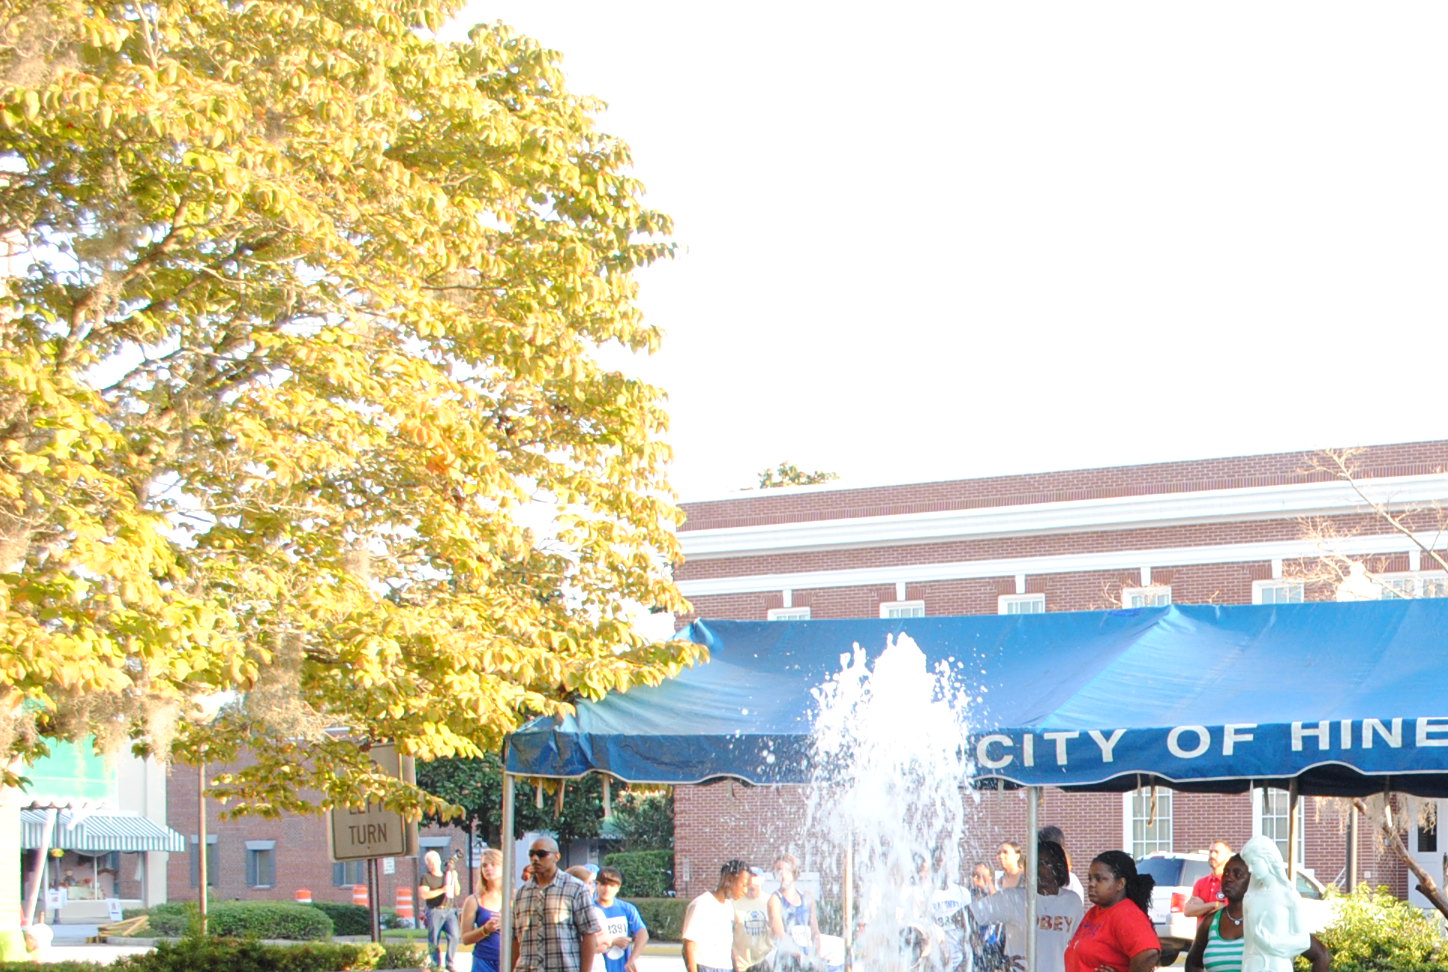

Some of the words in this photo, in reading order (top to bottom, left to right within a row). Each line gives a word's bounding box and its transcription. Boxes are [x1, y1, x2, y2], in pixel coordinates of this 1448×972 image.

[975, 728, 1128, 769] CITY
[1166, 722, 1258, 759] OF
[348, 823, 388, 846] TURN
[1036, 914, 1073, 933] BEY
